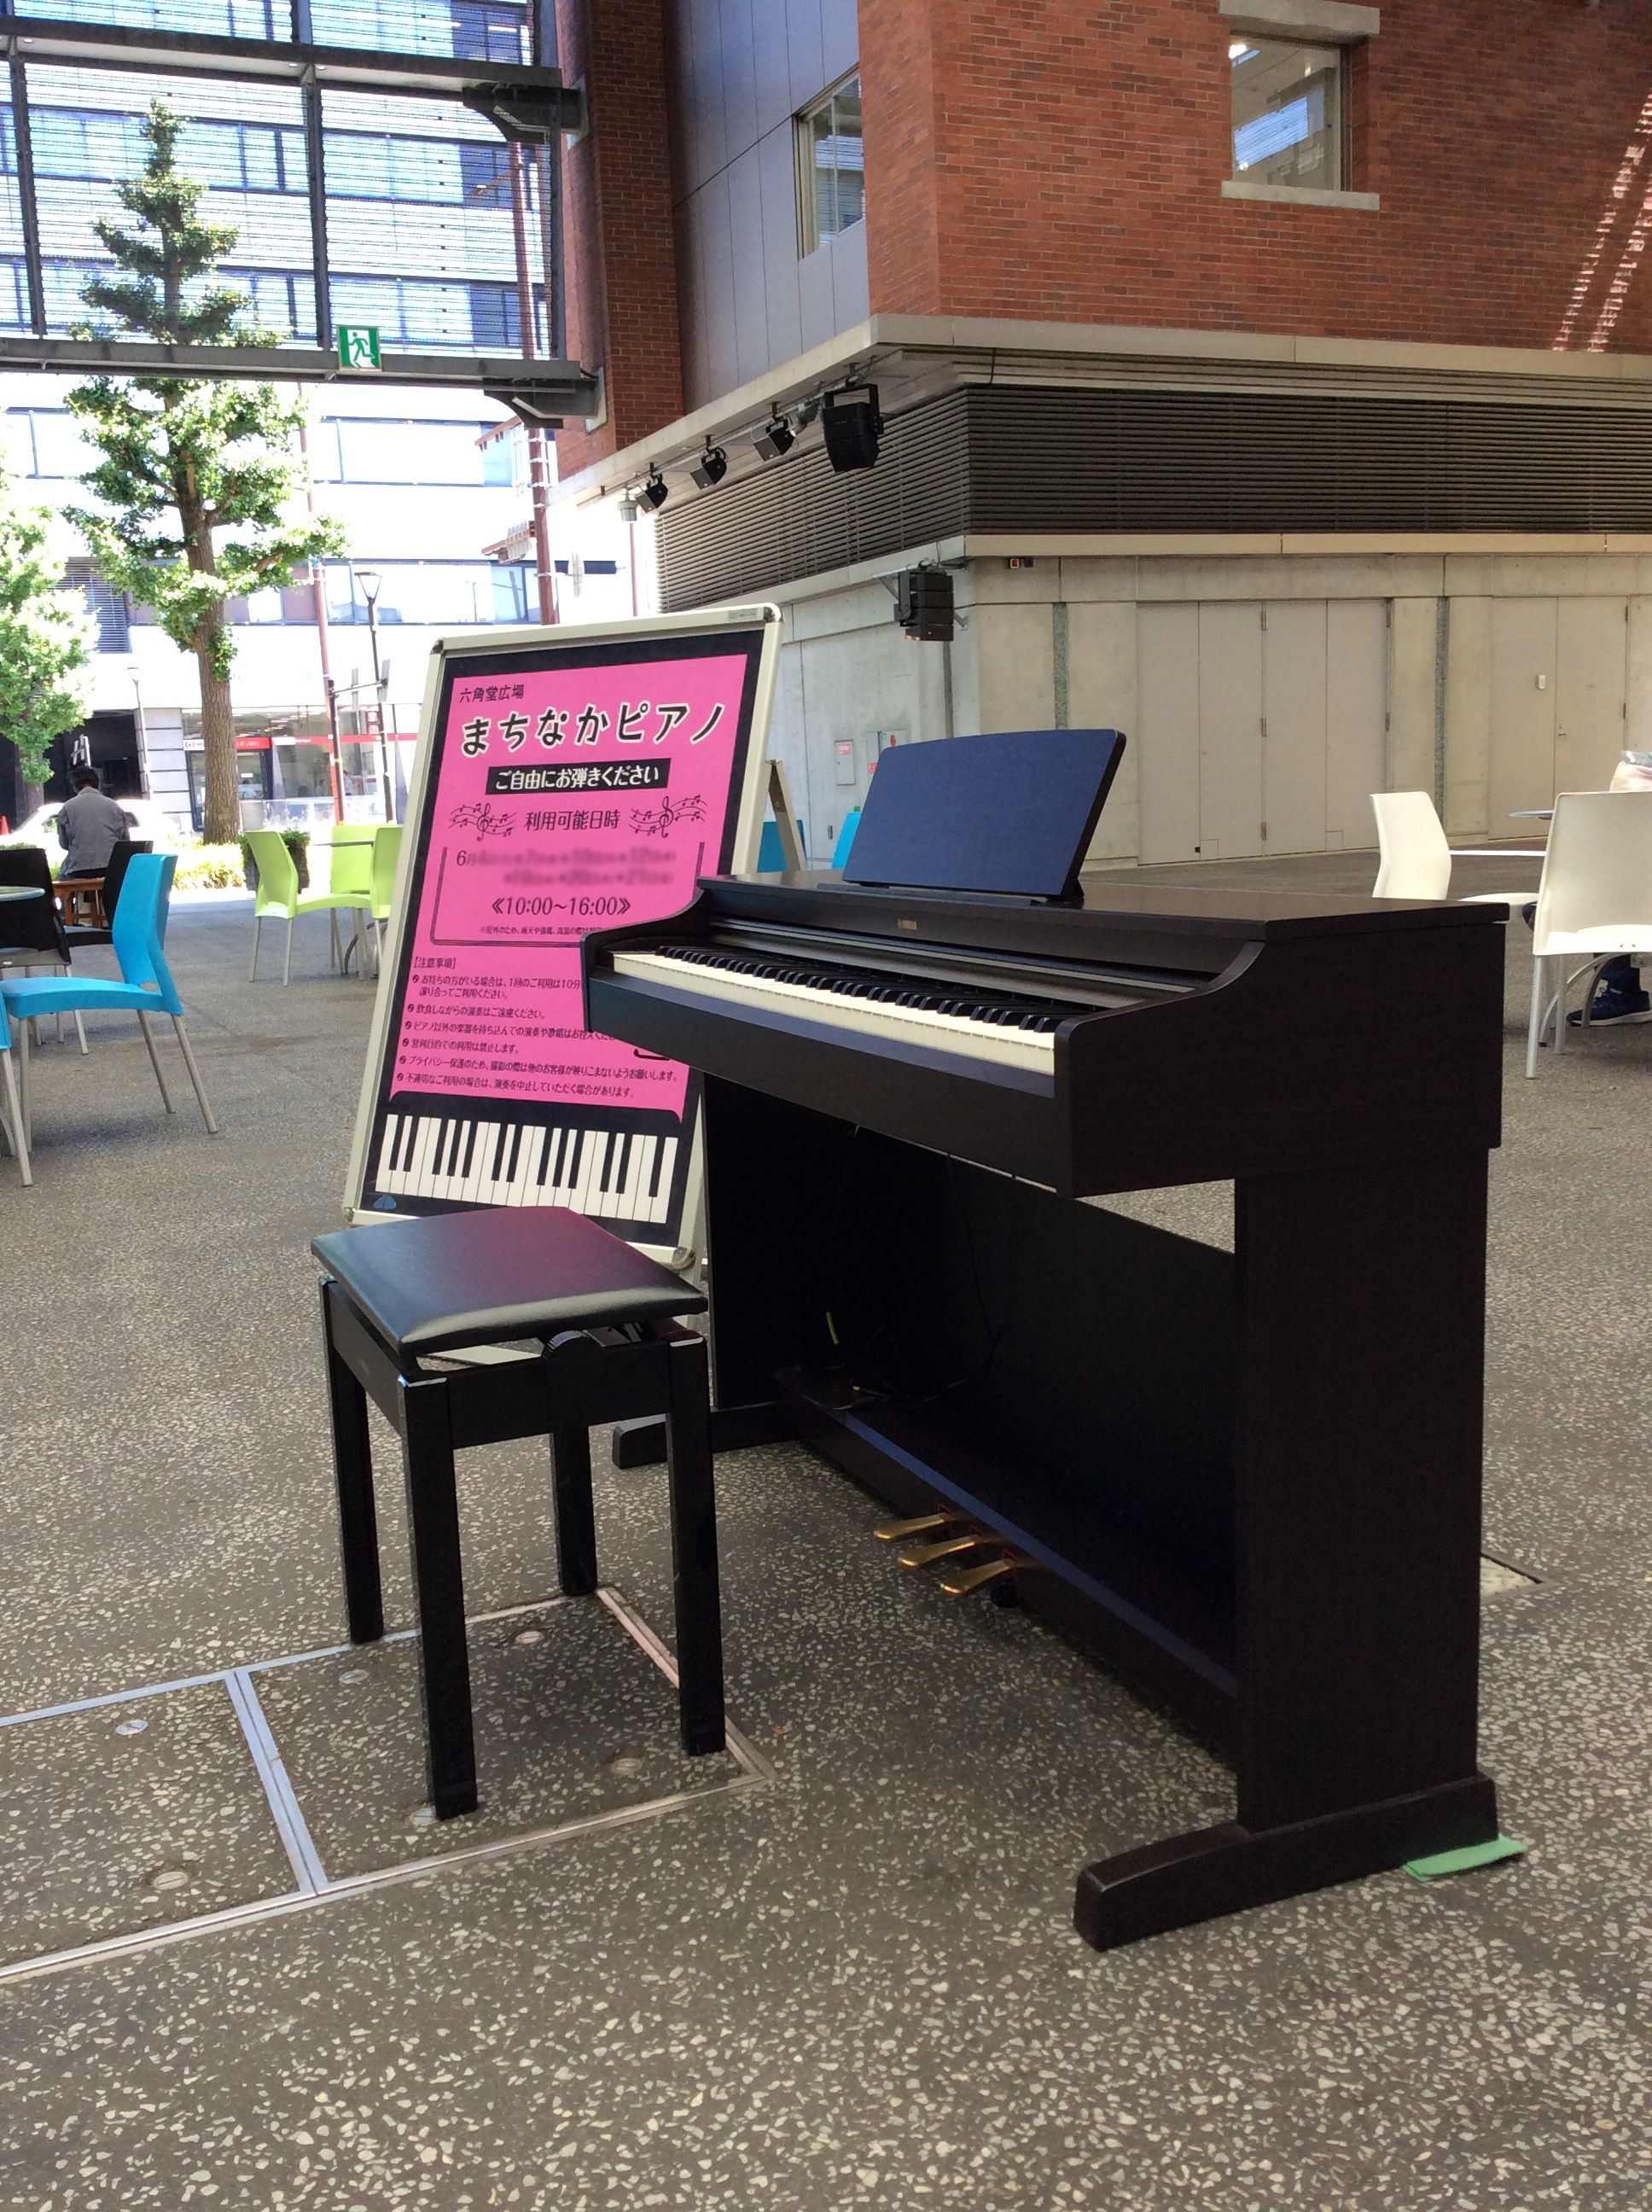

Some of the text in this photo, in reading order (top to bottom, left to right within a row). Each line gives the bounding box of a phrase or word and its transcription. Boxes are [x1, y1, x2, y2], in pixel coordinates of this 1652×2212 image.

[459, 684, 525, 703] 六角堂広場
[461, 700, 725, 759] まちなかピアノ
[495, 765, 660, 790] ご自由にお弾きください
[524, 809, 621, 831] 利用可能日時
[414, 957, 457, 969] 【注意事項】
[421, 974, 582, 990] お持ちの方がいる場合は、1回のご利用は10分
